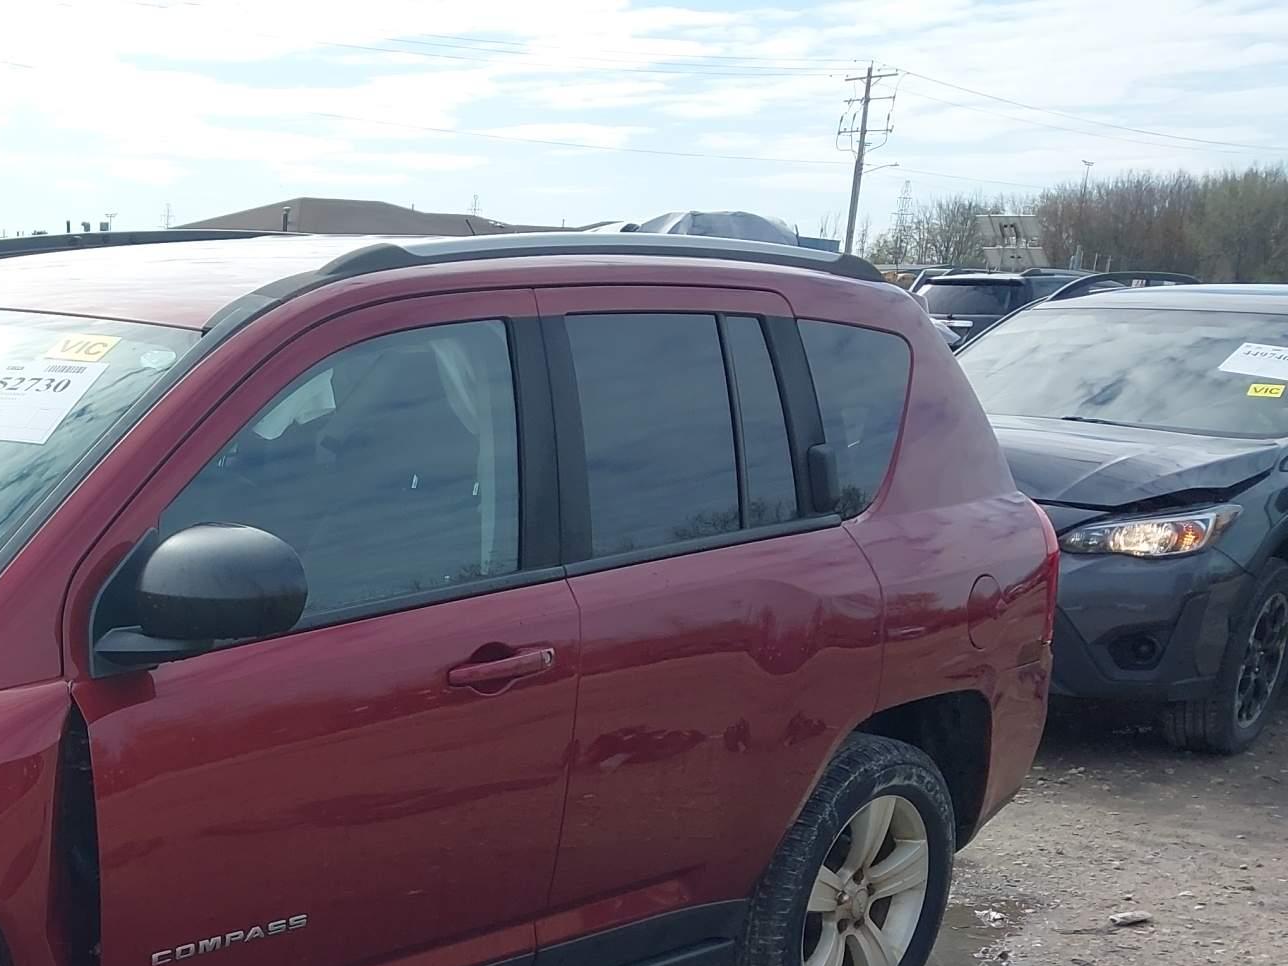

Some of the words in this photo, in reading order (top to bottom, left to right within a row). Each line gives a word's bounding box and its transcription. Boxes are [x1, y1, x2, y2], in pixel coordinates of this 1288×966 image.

[60, 338, 109, 356] VIC
[1253, 386, 1281, 395] VIC
[151, 914, 308, 966] COMPASS
